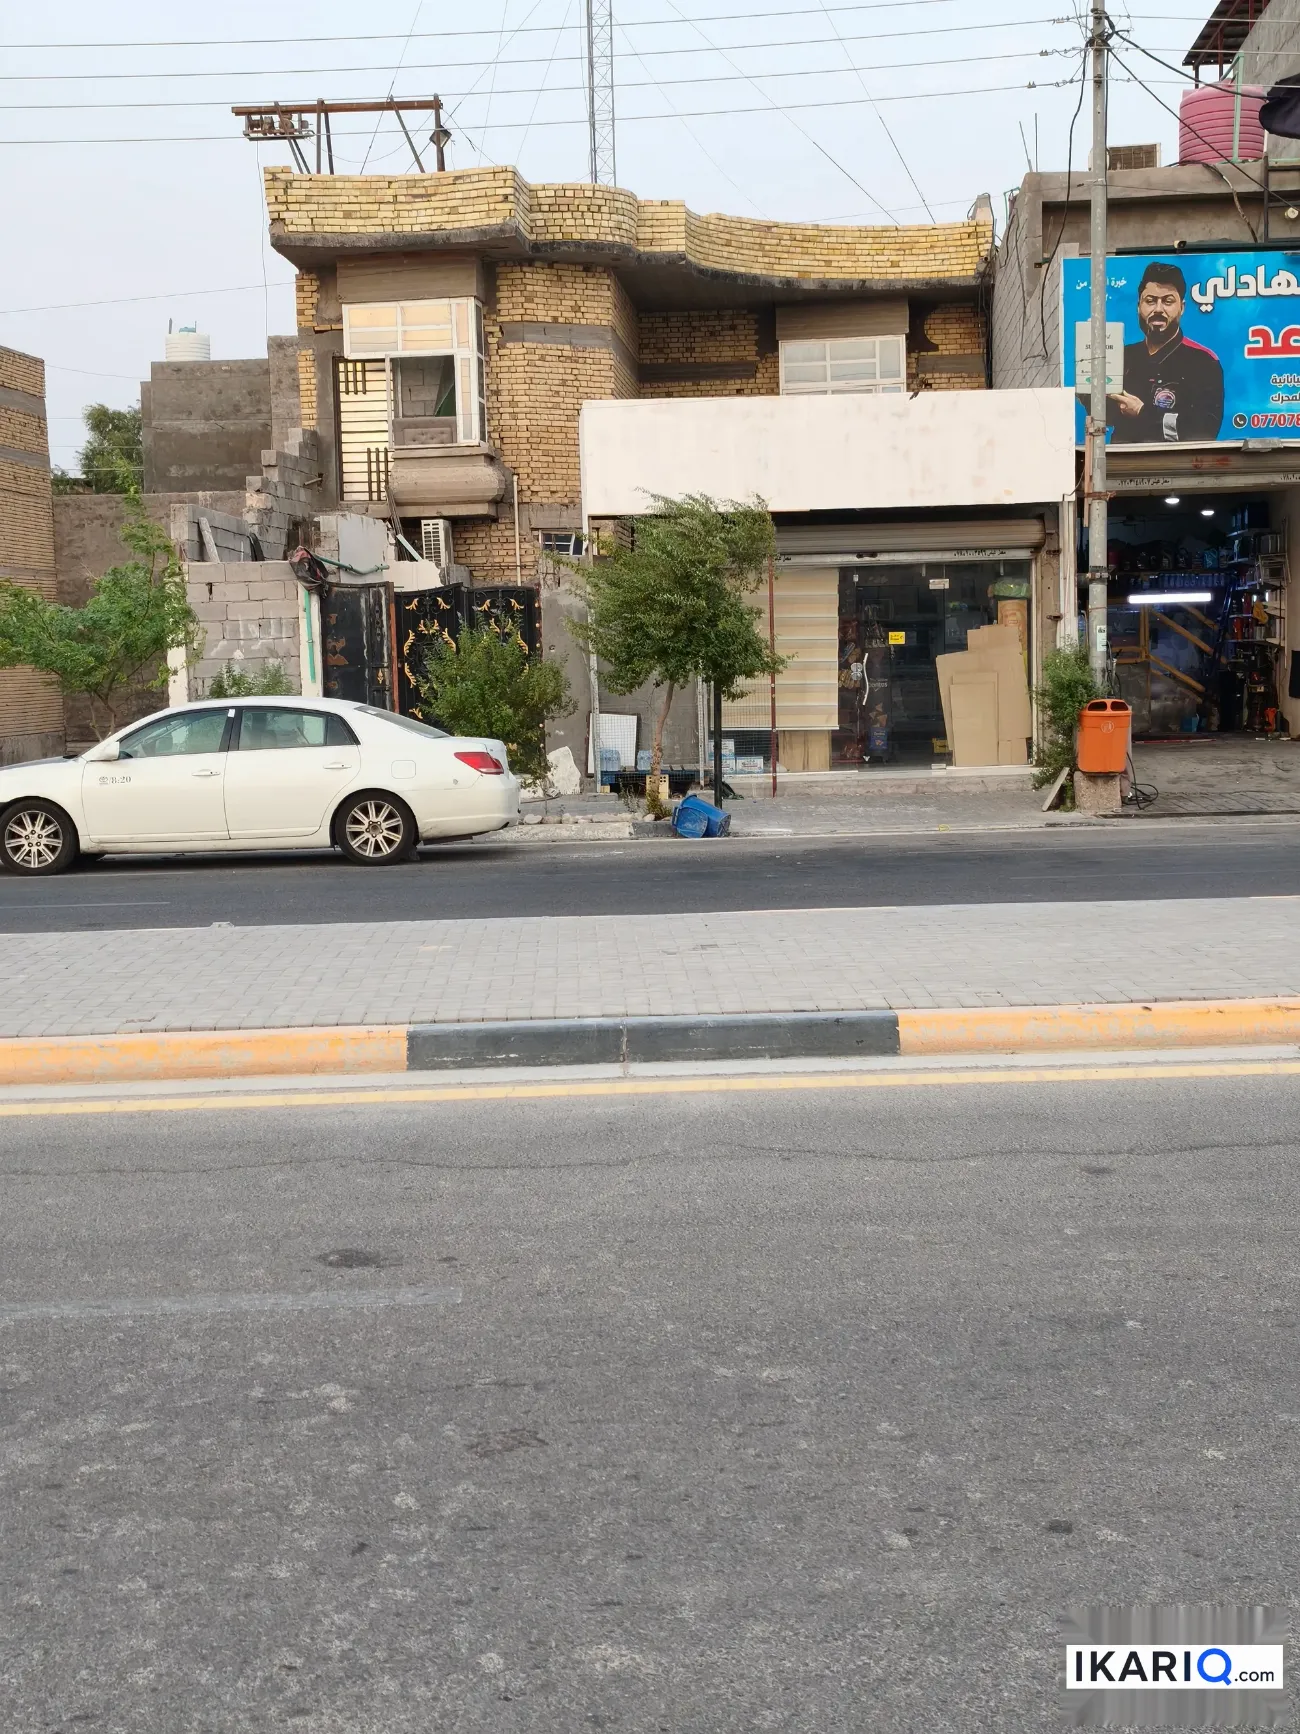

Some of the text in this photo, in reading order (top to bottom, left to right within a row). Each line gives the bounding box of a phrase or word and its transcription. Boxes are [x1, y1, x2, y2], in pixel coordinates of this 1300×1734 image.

[1076, 280, 1088, 290] من
[1111, 277, 1127, 288] خبرة
[1191, 264, 1300, 313] هادلي
